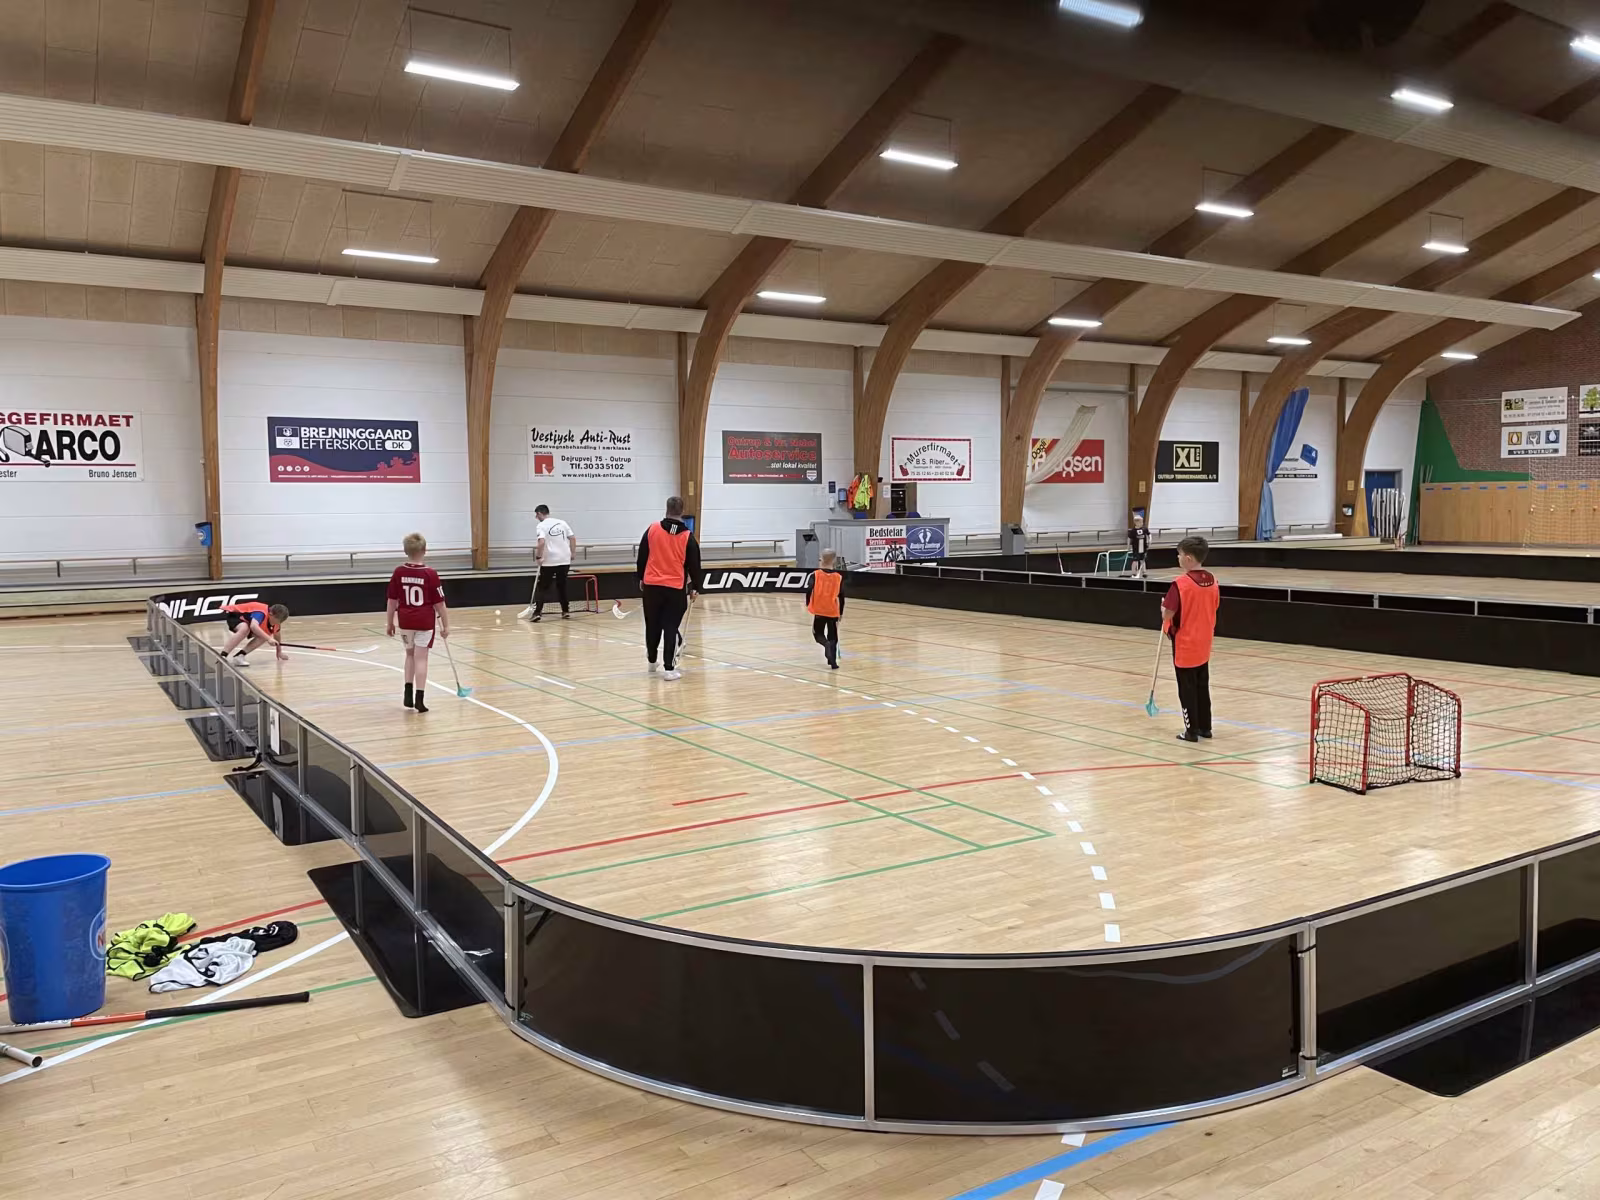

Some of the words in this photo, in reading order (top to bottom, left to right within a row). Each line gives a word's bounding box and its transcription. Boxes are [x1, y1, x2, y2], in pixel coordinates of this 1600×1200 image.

[300, 426, 412, 440] BREJNINGGAARD
[530, 427, 575, 445] Vestjysk
[579, 429, 631, 445] Anti-Rust
[35, 429, 121, 461] ARCO
[301, 438, 383, 451] EFTERSKOLE
[391, 441, 405, 450] DK
[727, 446, 817, 461] Autoservice
[906, 442, 959, 465] Murerfirmaet
[1175, 447, 1200, 468] XL
[88, 469, 110, 478] Bruno
[111, 469, 137, 479] Jensen
[702, 571, 812, 589] UNIHO
[402, 585, 425, 607] 10
